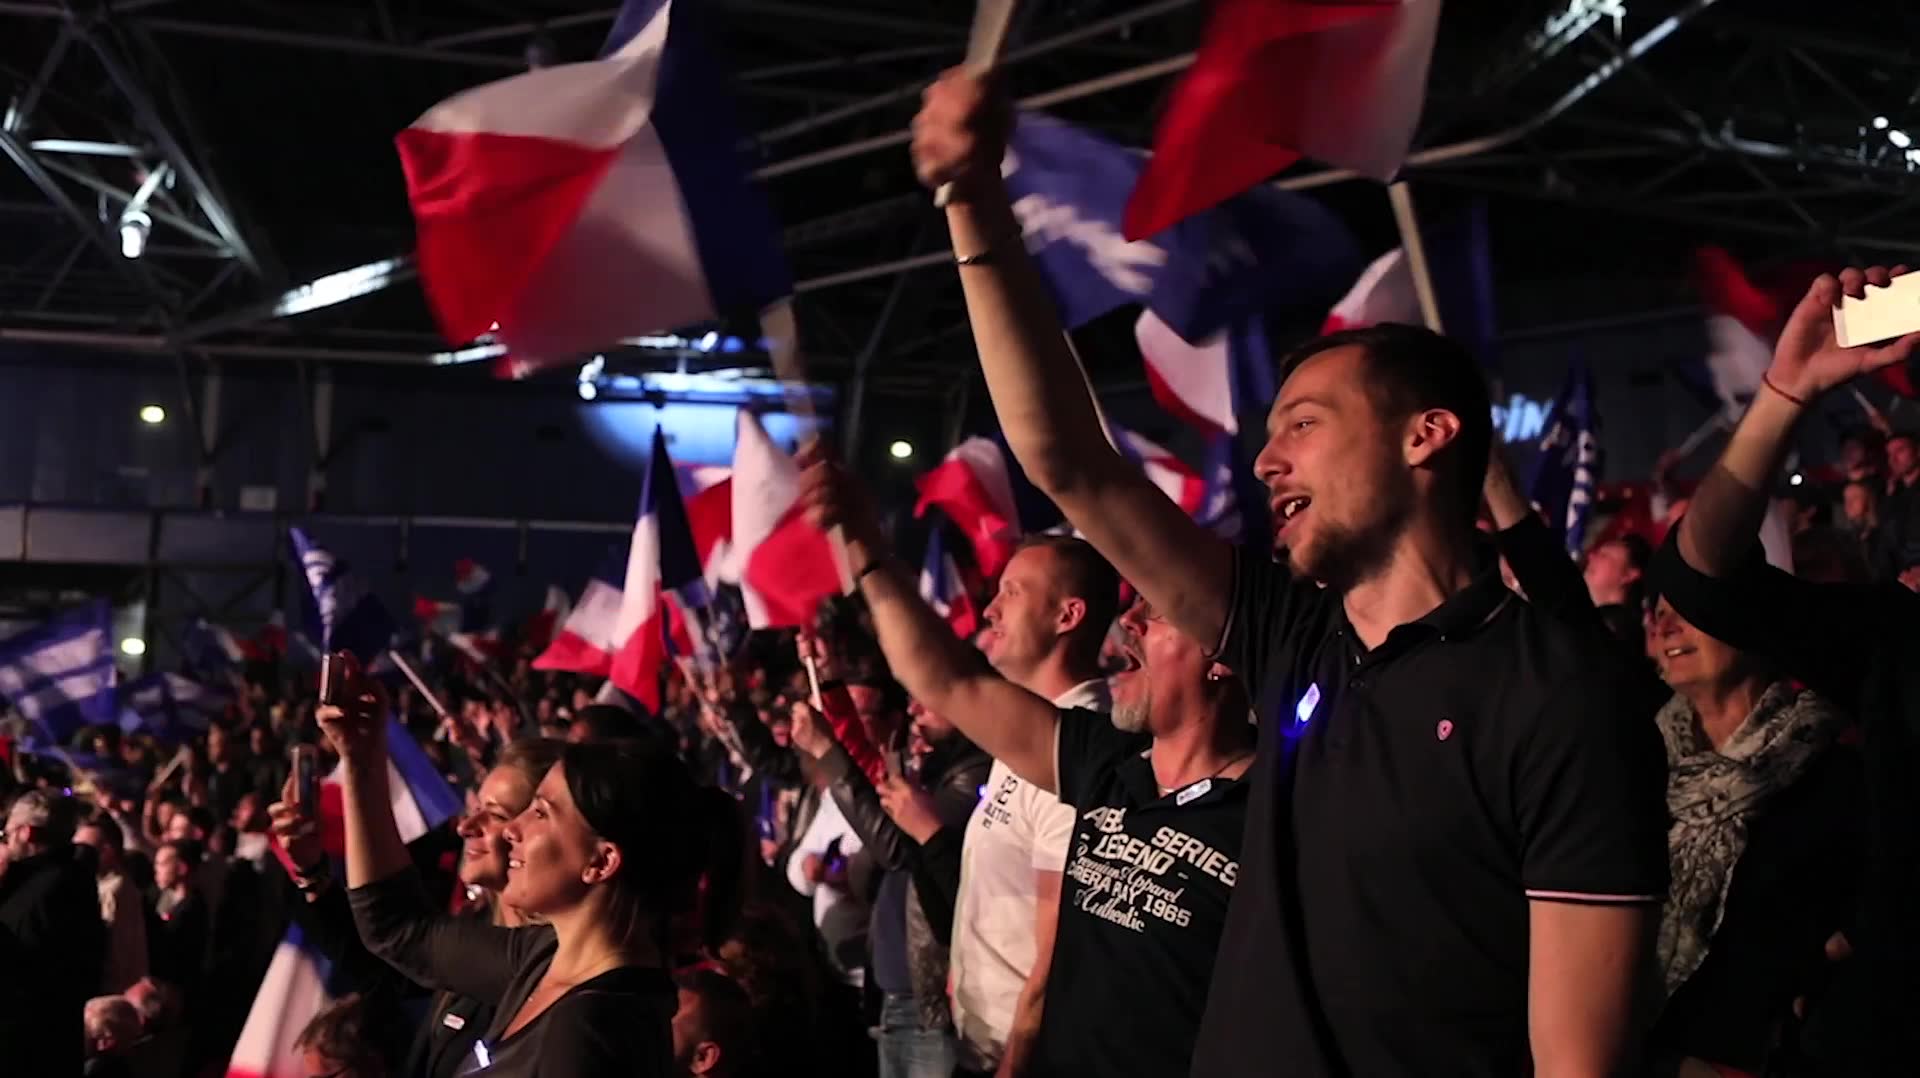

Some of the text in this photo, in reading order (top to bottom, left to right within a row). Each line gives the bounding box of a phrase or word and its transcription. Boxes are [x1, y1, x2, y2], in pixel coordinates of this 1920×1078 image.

[1092, 833, 1175, 876] LEGEND
[1151, 826, 1239, 887] SERIES
[1074, 886, 1145, 932] Authentic
[1142, 894, 1192, 927] 1965
